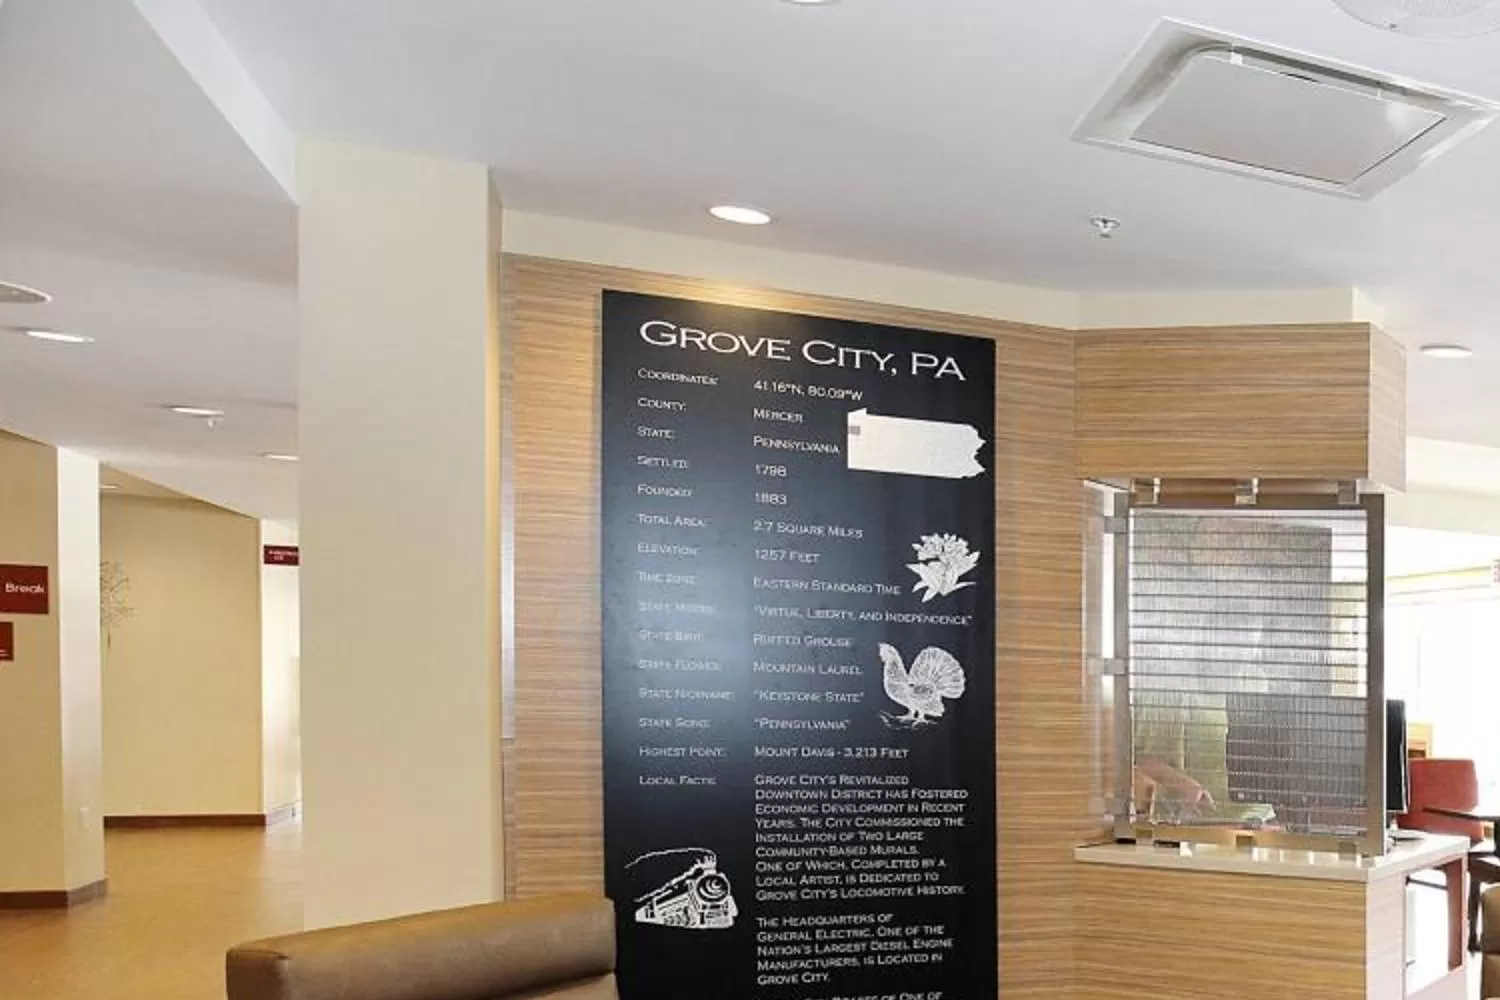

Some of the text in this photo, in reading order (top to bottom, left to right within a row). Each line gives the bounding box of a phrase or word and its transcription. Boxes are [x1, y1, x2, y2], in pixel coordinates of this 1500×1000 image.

[639, 320, 966, 381] GROVE CITY, PA
[753, 407, 804, 424] MERCER
[753, 435, 841, 455] PENNSYLVANIA
[755, 464, 788, 478] 1798
[776, 522, 827, 537] SQUARE
[828, 525, 864, 539] MILES
[755, 550, 787, 561] 1257
[5, 582, 45, 593] Break
[753, 576, 902, 596] EASTERN STANDARD TIME
[753, 662, 817, 675] MOUNTAIN
[754, 747, 799, 758] MOUNT
[754, 774, 797, 786] GROVE
[839, 774, 909, 786] REVITALIZED
[754, 788, 969, 800] DOWNTOWN DISTRICT HAS FOSTERED
[755, 801, 966, 815] ECONOMIC DEVELOPMENT IN RECENT
[799, 818, 824, 829] THE
[825, 817, 852, 829] CITY
[854, 816, 942, 828] COMMISSIONED
[943, 816, 965, 827] THE
[755, 831, 925, 844] INSTALLATION OF TWO LARGE
[755, 860, 783, 873] ONE
[785, 861, 802, 872] OF
[851, 858, 920, 870] COMPLETED
[921, 858, 936, 869] BY
[937, 858, 947, 868] A
[755, 874, 798, 888] LOCAL
[859, 872, 922, 884] DEDICATED
[924, 872, 940, 882] TO
[755, 888, 799, 901] GROVE
[840, 885, 915, 899] LOCOMOTIVE
[756, 913, 894, 928] THE HEADQUARTERS OF
[756, 930, 813, 943] GENERAL
[876, 925, 903, 937] ONE
[905, 926, 922, 936] OF
[924, 924, 945, 935] THE
[815, 941, 867, 955] LARGEST
[869, 939, 911, 952] DIESEL
[912, 937, 954, 949] ENGINE
[877, 953, 930, 966] LOCATED
[931, 952, 944, 962] IN
[757, 972, 799, 986] GROVE
[927, 991, 943, 1000] OF
